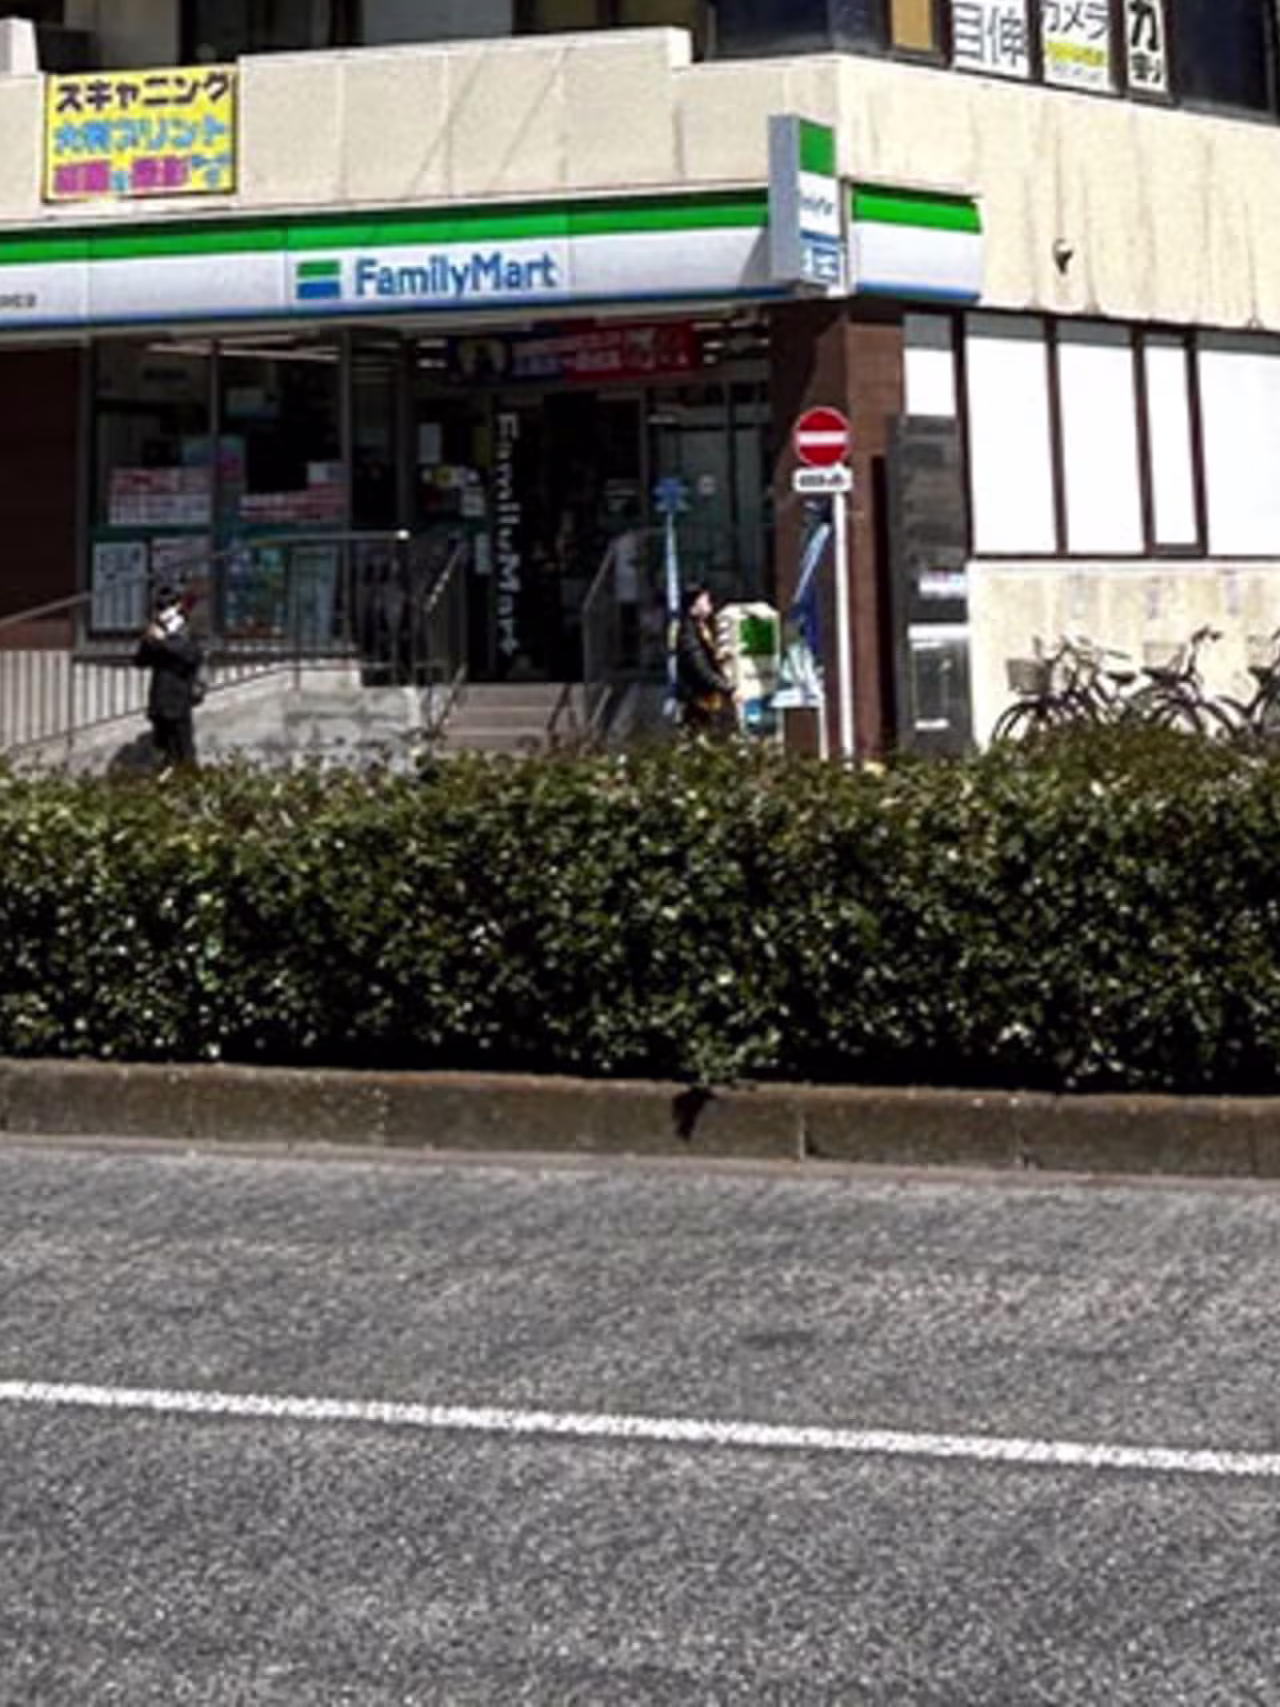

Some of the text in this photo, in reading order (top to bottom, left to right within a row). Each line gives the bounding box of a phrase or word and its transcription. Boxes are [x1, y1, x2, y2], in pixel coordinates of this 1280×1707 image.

[56, 71, 230, 112] スキャニング
[355, 250, 557, 299] FamilyMart
[497, 412, 521, 656] FamilyMart
